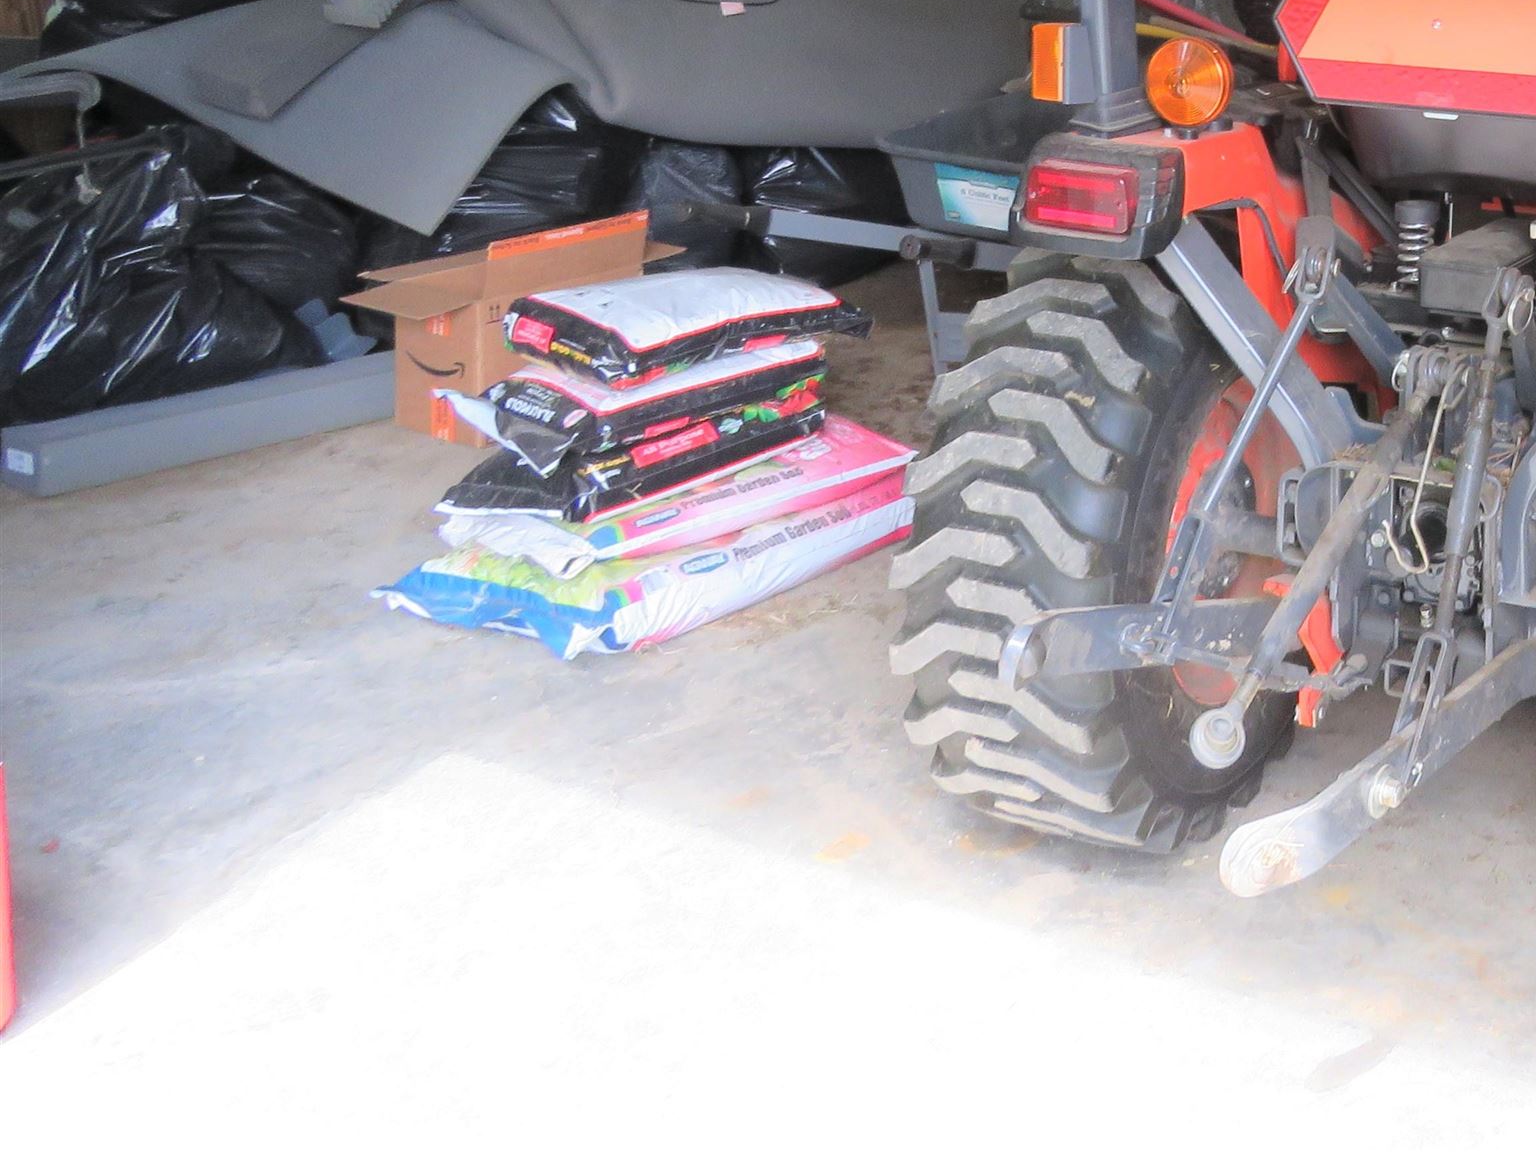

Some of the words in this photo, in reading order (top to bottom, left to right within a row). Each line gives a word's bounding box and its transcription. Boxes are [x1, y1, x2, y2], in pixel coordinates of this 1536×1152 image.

[732, 531, 788, 561] Premium
[784, 514, 830, 539] Garden
[826, 505, 852, 524] Soil
